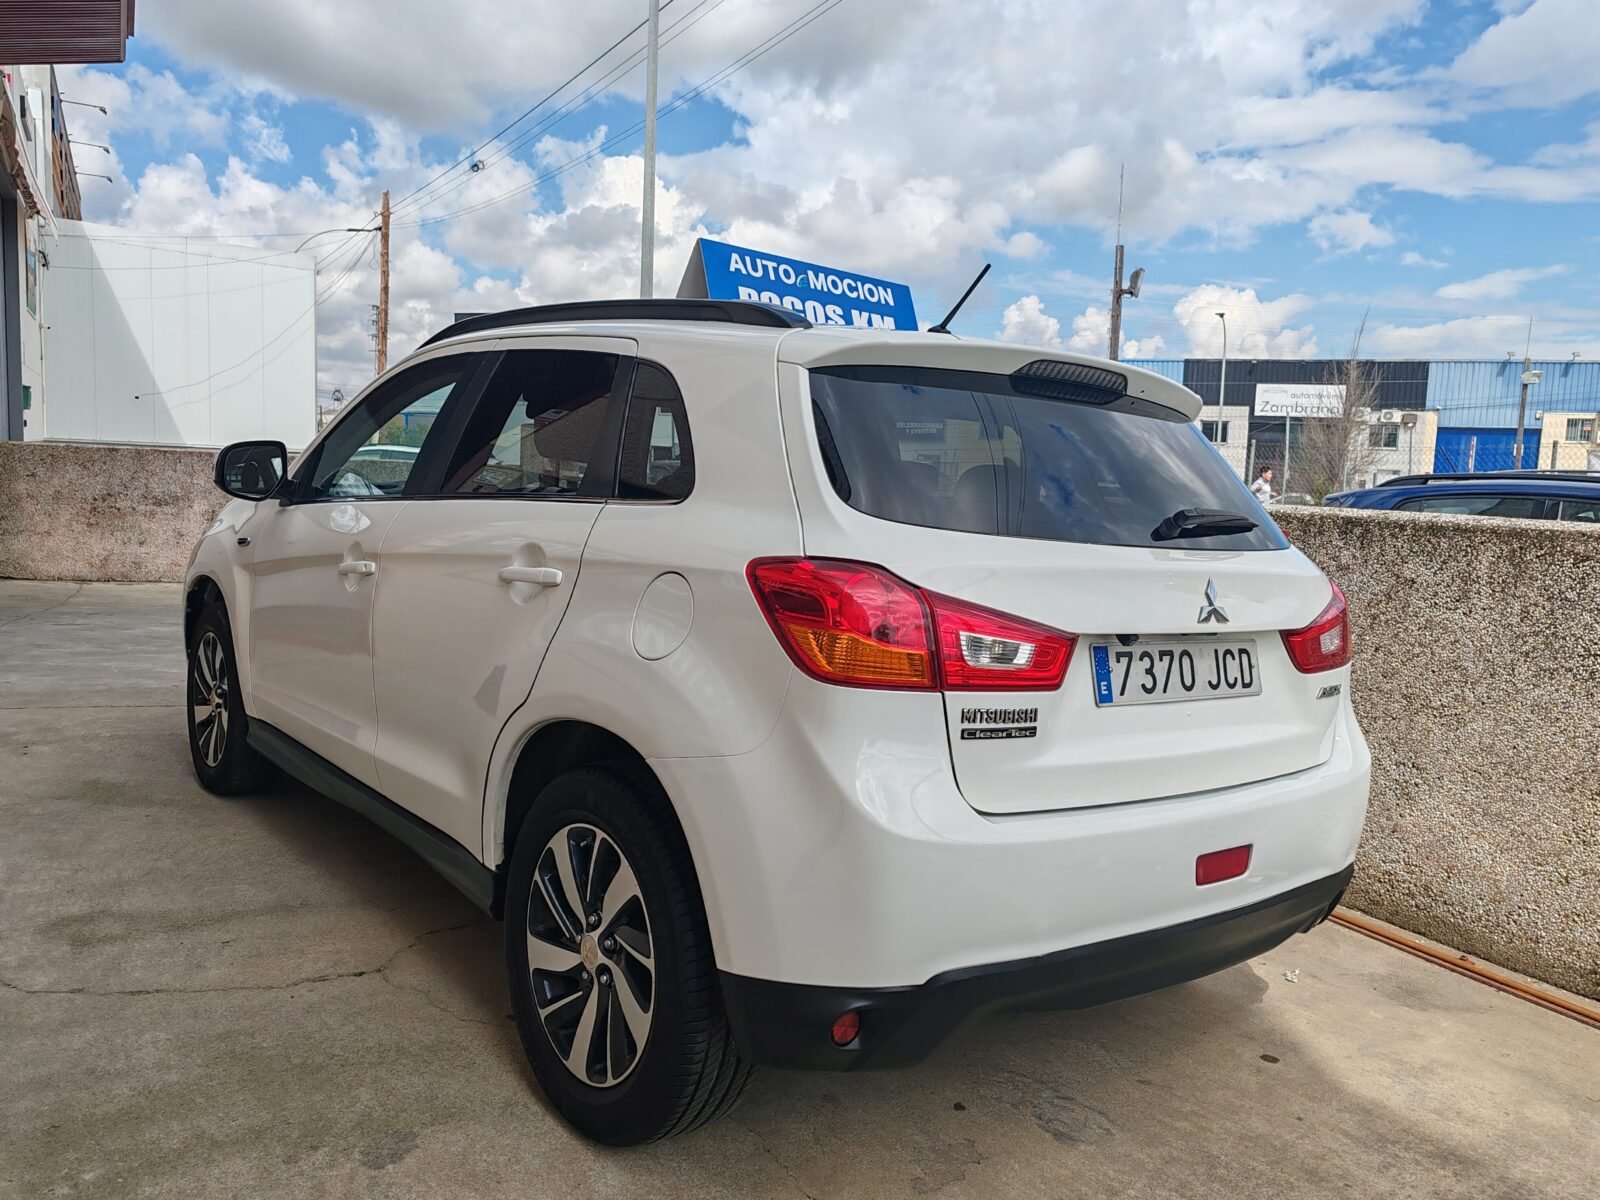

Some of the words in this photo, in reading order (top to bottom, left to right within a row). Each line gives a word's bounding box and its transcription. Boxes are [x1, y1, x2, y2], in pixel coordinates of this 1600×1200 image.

[851, 309, 896, 330] KM
[1115, 650, 1196, 697] 7370
[1207, 648, 1254, 690] JCD
[1101, 681, 1108, 695] E
[960, 707, 1038, 724] MITSUBISHI
[963, 729, 1035, 738] ClearTec
